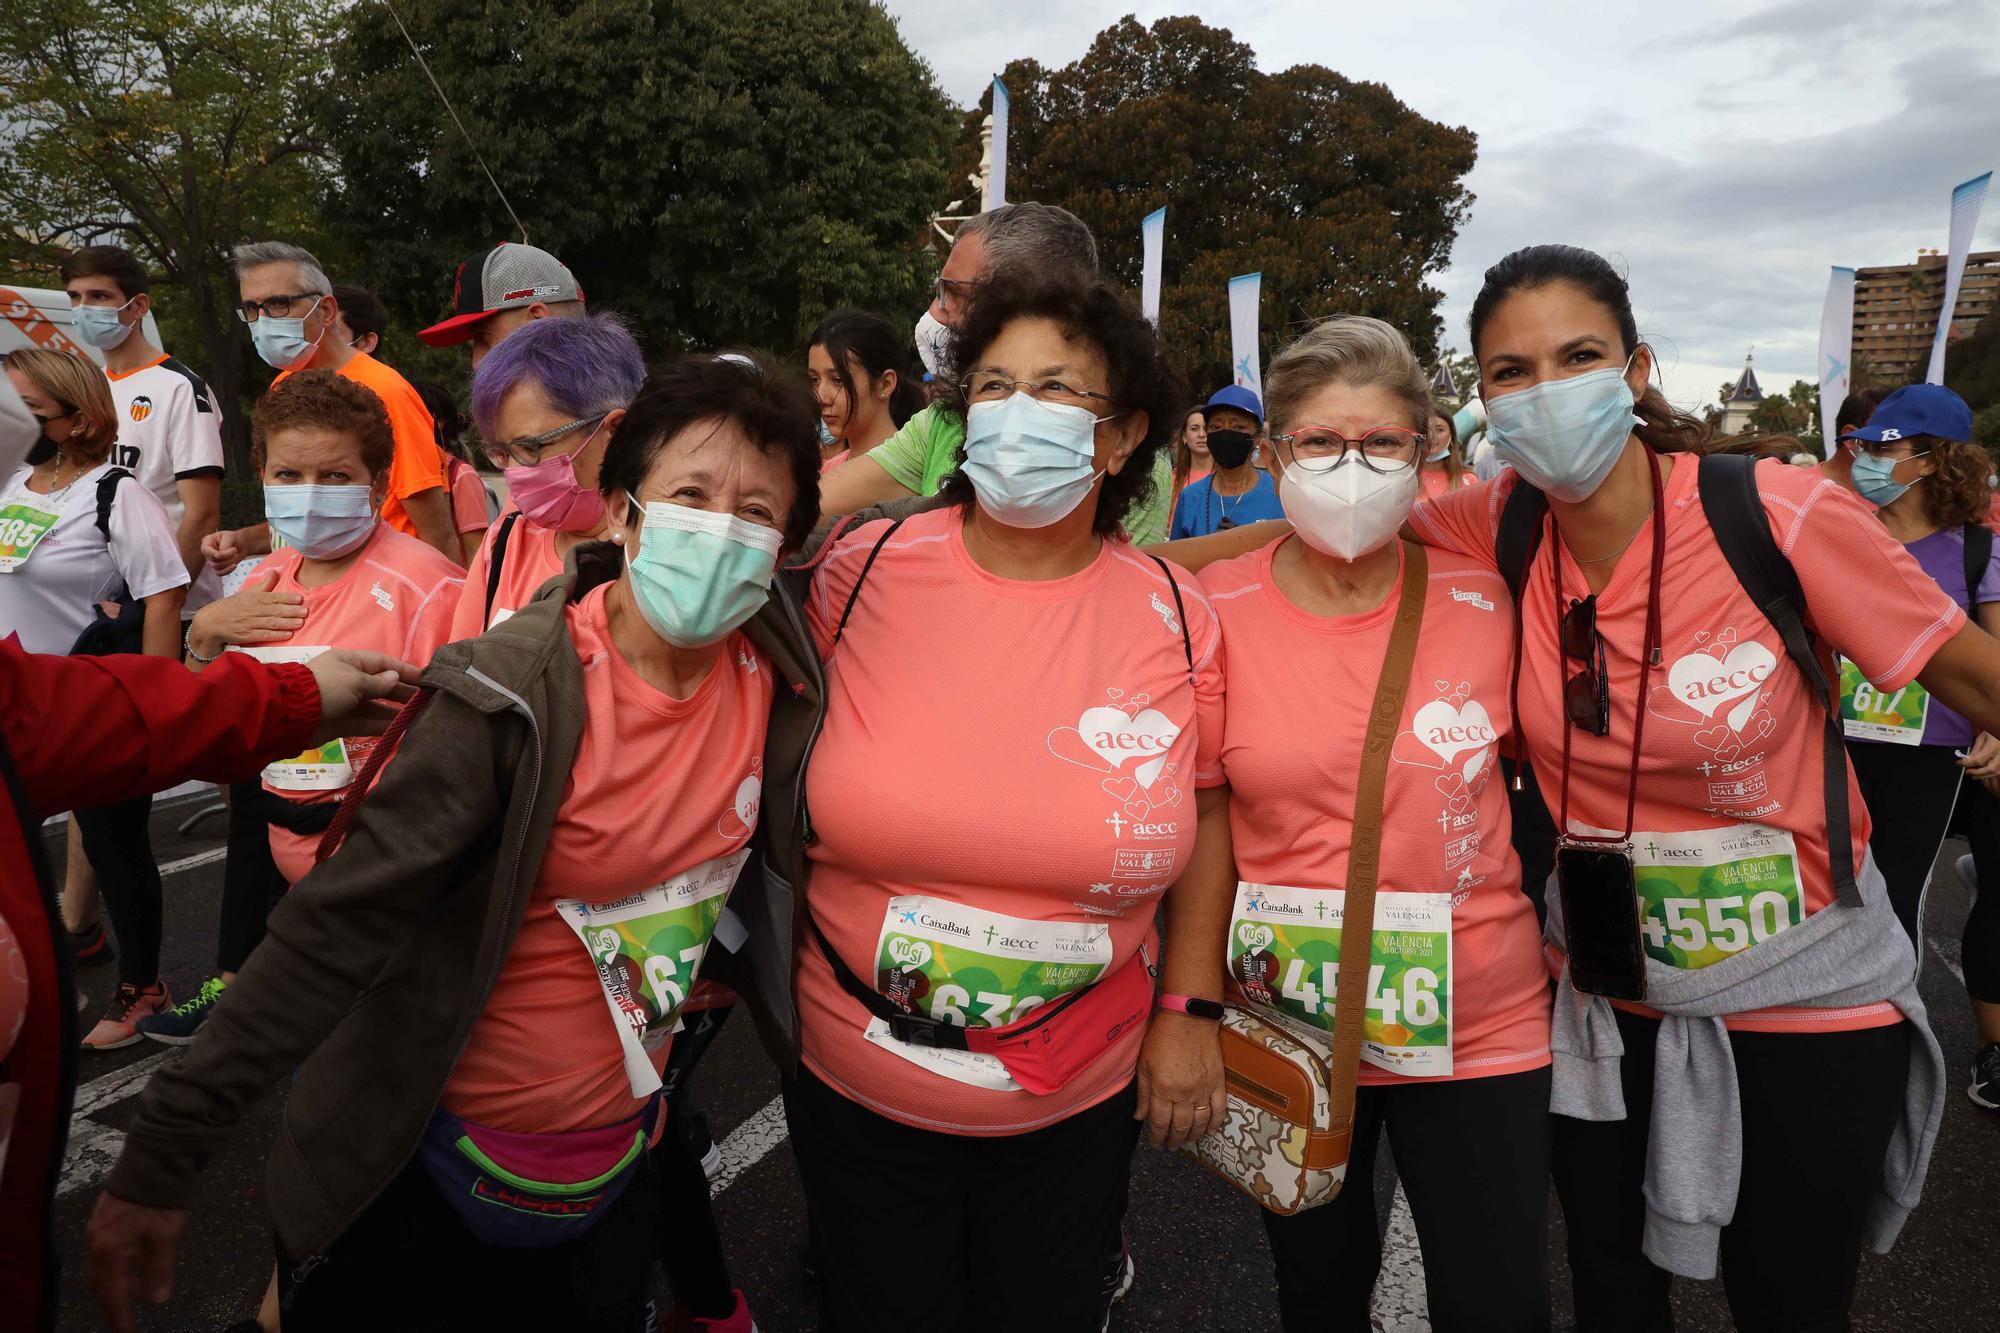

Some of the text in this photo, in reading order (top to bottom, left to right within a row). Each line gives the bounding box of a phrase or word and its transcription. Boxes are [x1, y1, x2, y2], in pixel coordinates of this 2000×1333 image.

[1684, 664, 1766, 700] aecc
[1095, 731, 1173, 751] aecc
[1429, 725, 1493, 745] aecc
[1721, 752, 1765, 773] aecc
[1724, 800, 1782, 817] CaixaBank
[1132, 822, 1177, 835] aecc
[1663, 848, 1704, 857] aecc
[1732, 873, 1761, 885] OCTUBRE
[1763, 871, 1778, 881] 2021
[677, 878, 701, 896] aecc
[1261, 901, 1304, 914] CaixaBank
[920, 914, 1038, 951] CaixaBank aecc
[1244, 926, 1256, 939] YO
[895, 941, 910, 956] YO
